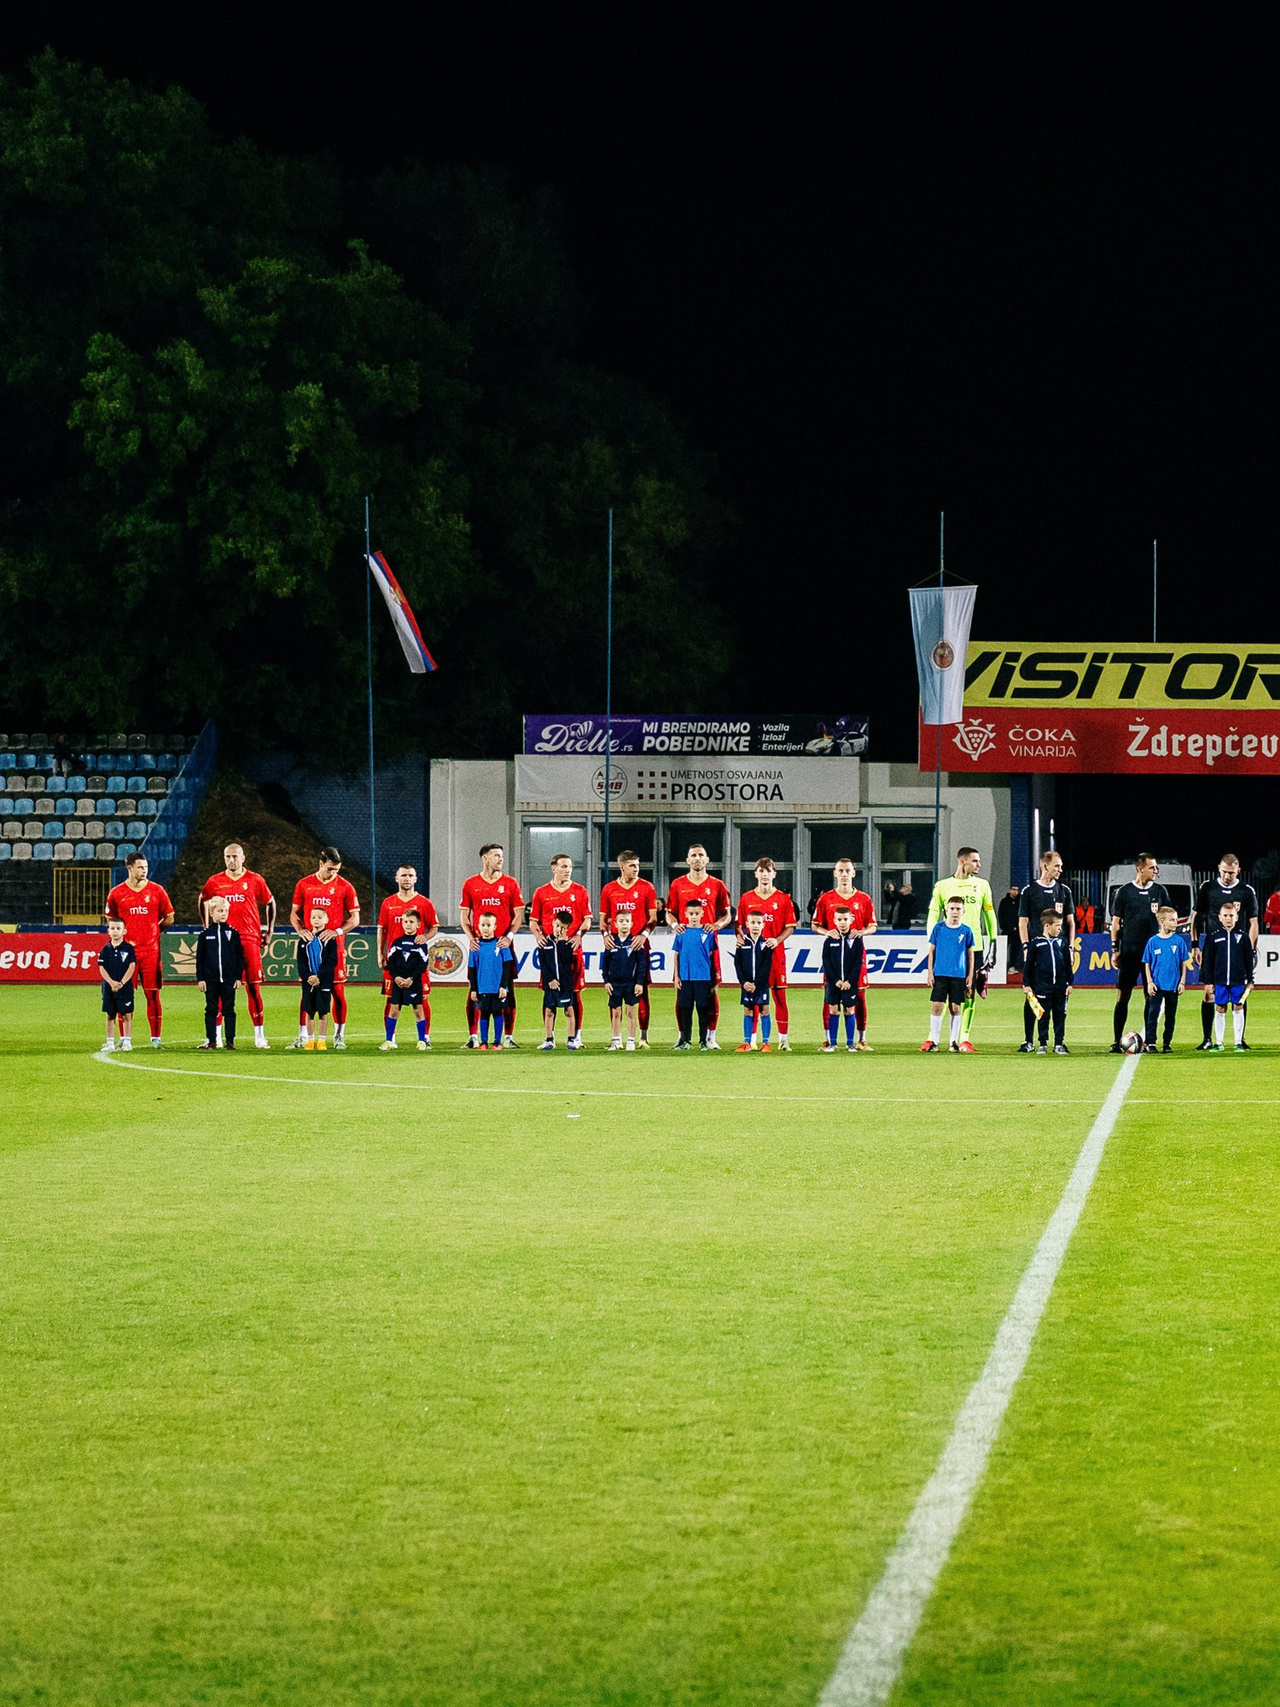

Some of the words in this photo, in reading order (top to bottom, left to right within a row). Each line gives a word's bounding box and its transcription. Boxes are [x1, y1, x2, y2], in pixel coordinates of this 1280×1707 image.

[642, 721, 658, 734] MI
[661, 722, 750, 734] BRENDIRAMO
[762, 723, 790, 732] Vozila
[762, 733, 786, 742] Izlozi
[1008, 725, 1076, 742] ČOKA
[643, 736, 750, 752] POBEDNIKE
[762, 742, 804, 753] Enterijeri
[1008, 745, 1077, 758] VINARIJA
[670, 771, 724, 780] UMETNOST
[727, 770, 784, 781] OSVAJANJA
[671, 783, 784, 801] PROSTORA
[225, 893, 245, 903] mts
[312, 897, 331, 907] mts
[481, 897, 501, 906] mts
[129, 905, 149, 915] mts
[616, 901, 636, 910] mts
[0, 950, 51, 969] eva
[61, 942, 101, 969] kr
